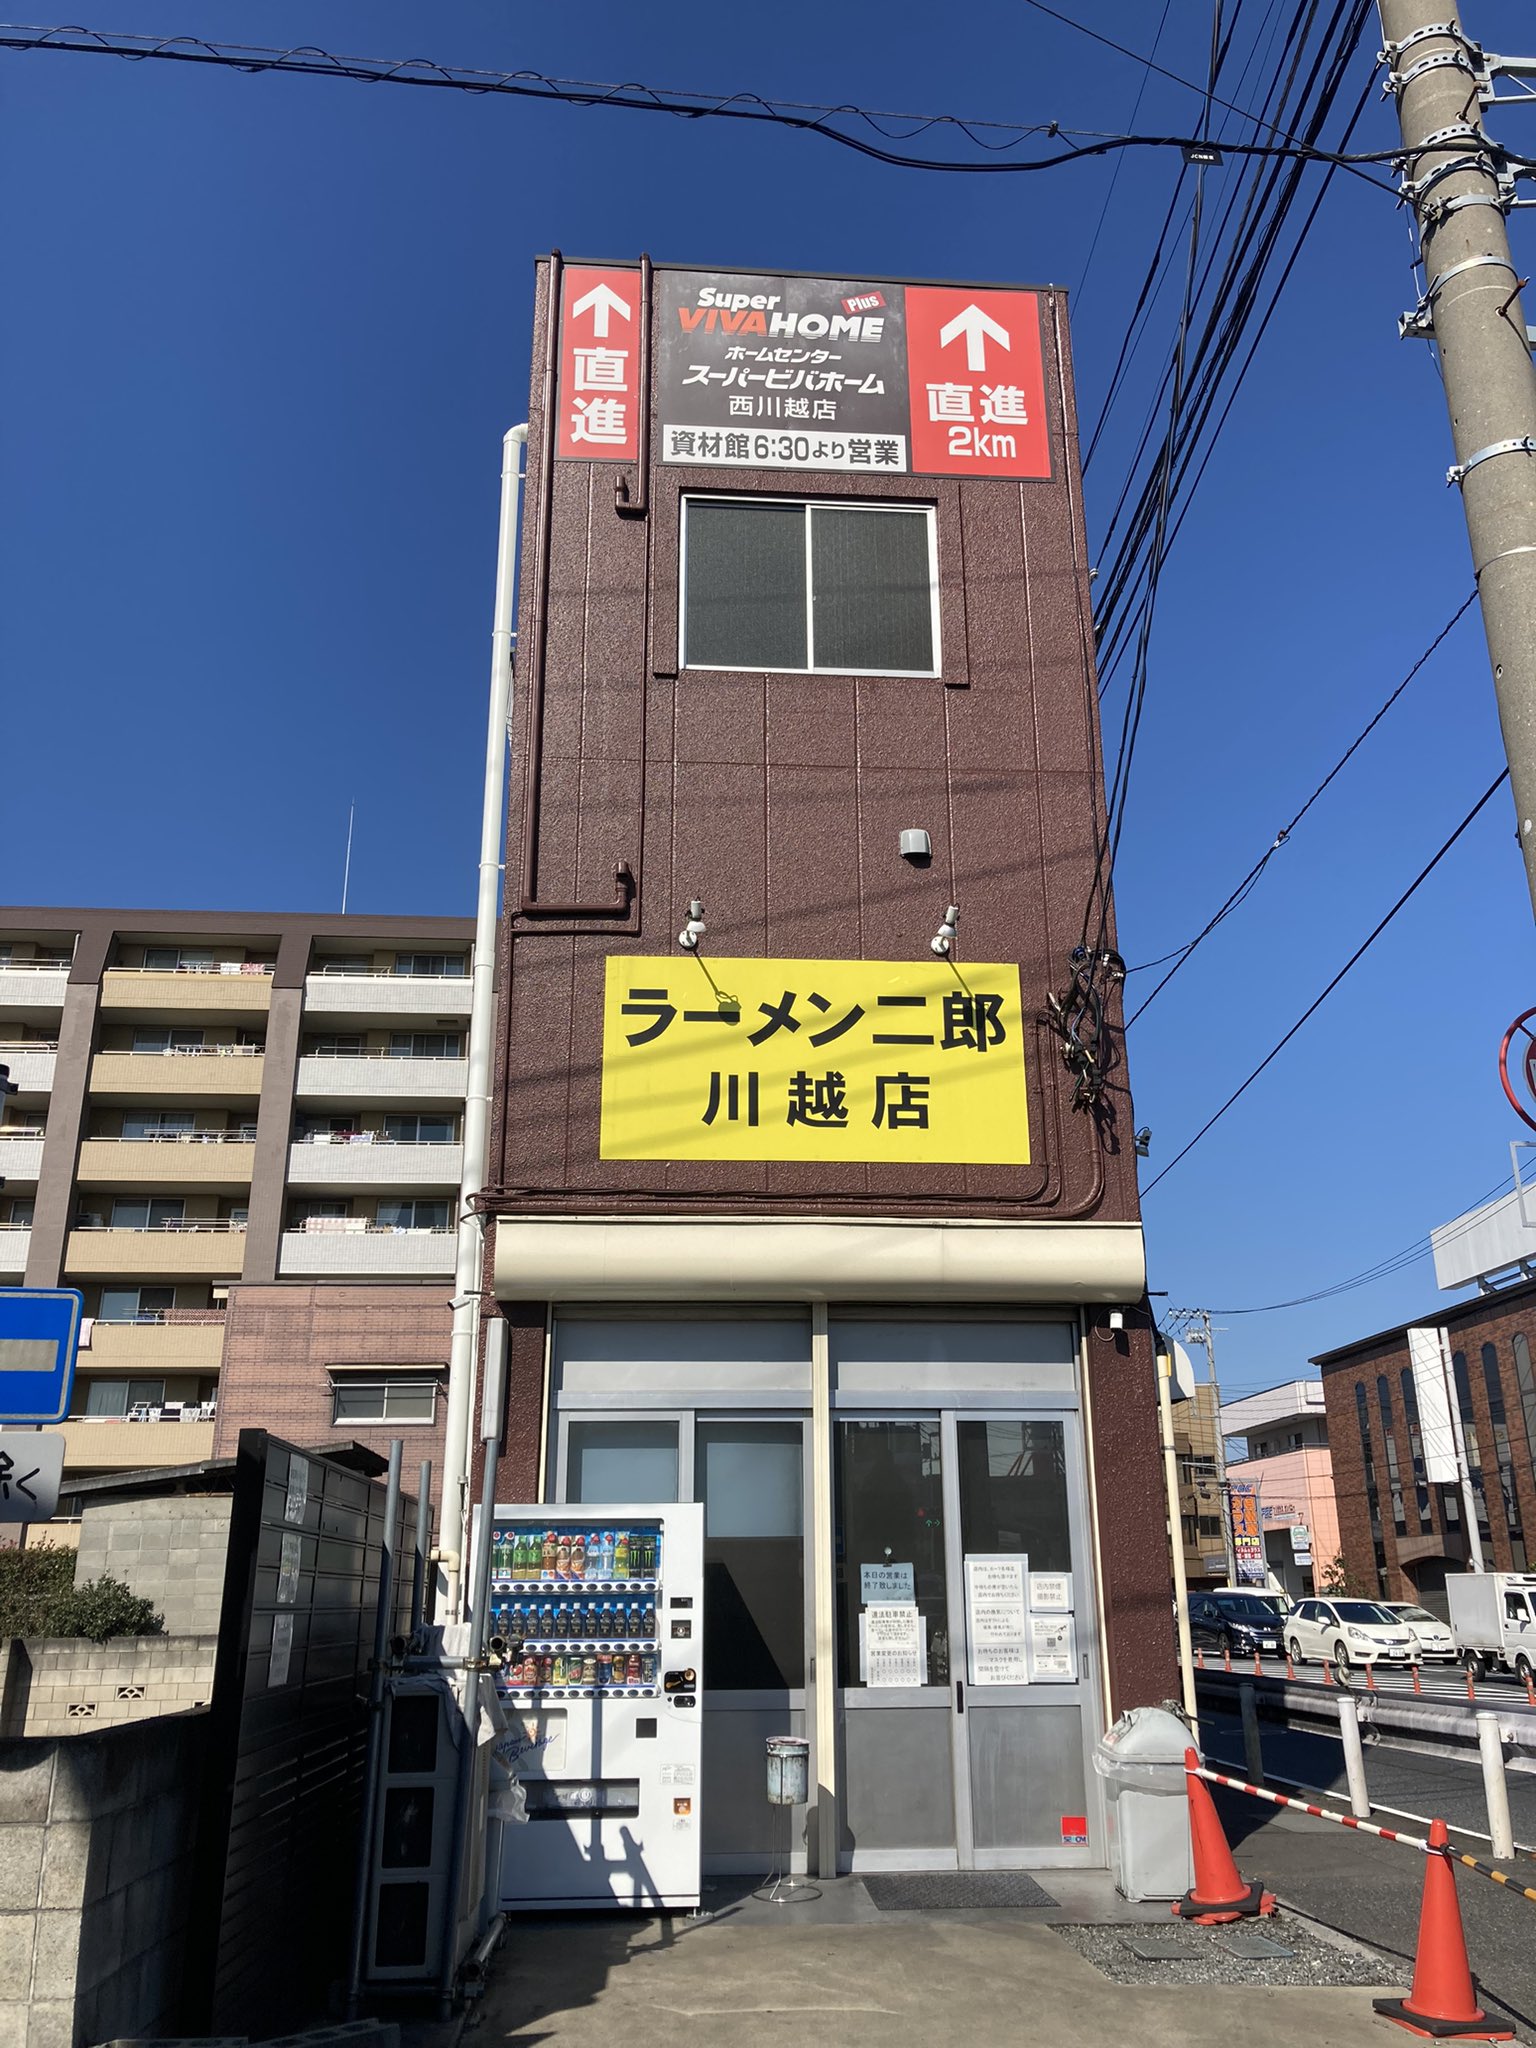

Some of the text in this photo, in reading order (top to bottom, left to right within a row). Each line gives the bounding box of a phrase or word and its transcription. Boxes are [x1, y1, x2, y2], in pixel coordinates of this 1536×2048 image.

[697, 287, 780, 311] Super
[846, 294, 880, 311] Plus
[724, 346, 842, 362] ホームセンター
[682, 364, 886, 396] スーパービバホーム
[569, 346, 628, 446] 直進
[728, 395, 837, 421] 西川越店
[925, 381, 1029, 427] 直進
[670, 429, 901, 466] 資材館6:30より営業
[948, 425, 1017, 459] 2km
[621, 988, 1007, 1053] ラーメン二郎
[702, 1070, 932, 1130] 川越店
[863, 1571, 908, 1579] 本日の営業は
[864, 1580, 912, 1590] 終了致しました
[871, 1610, 912, 1618] 違法駐車禁止
[870, 1649, 917, 1657] 営業変更のお知らせ
